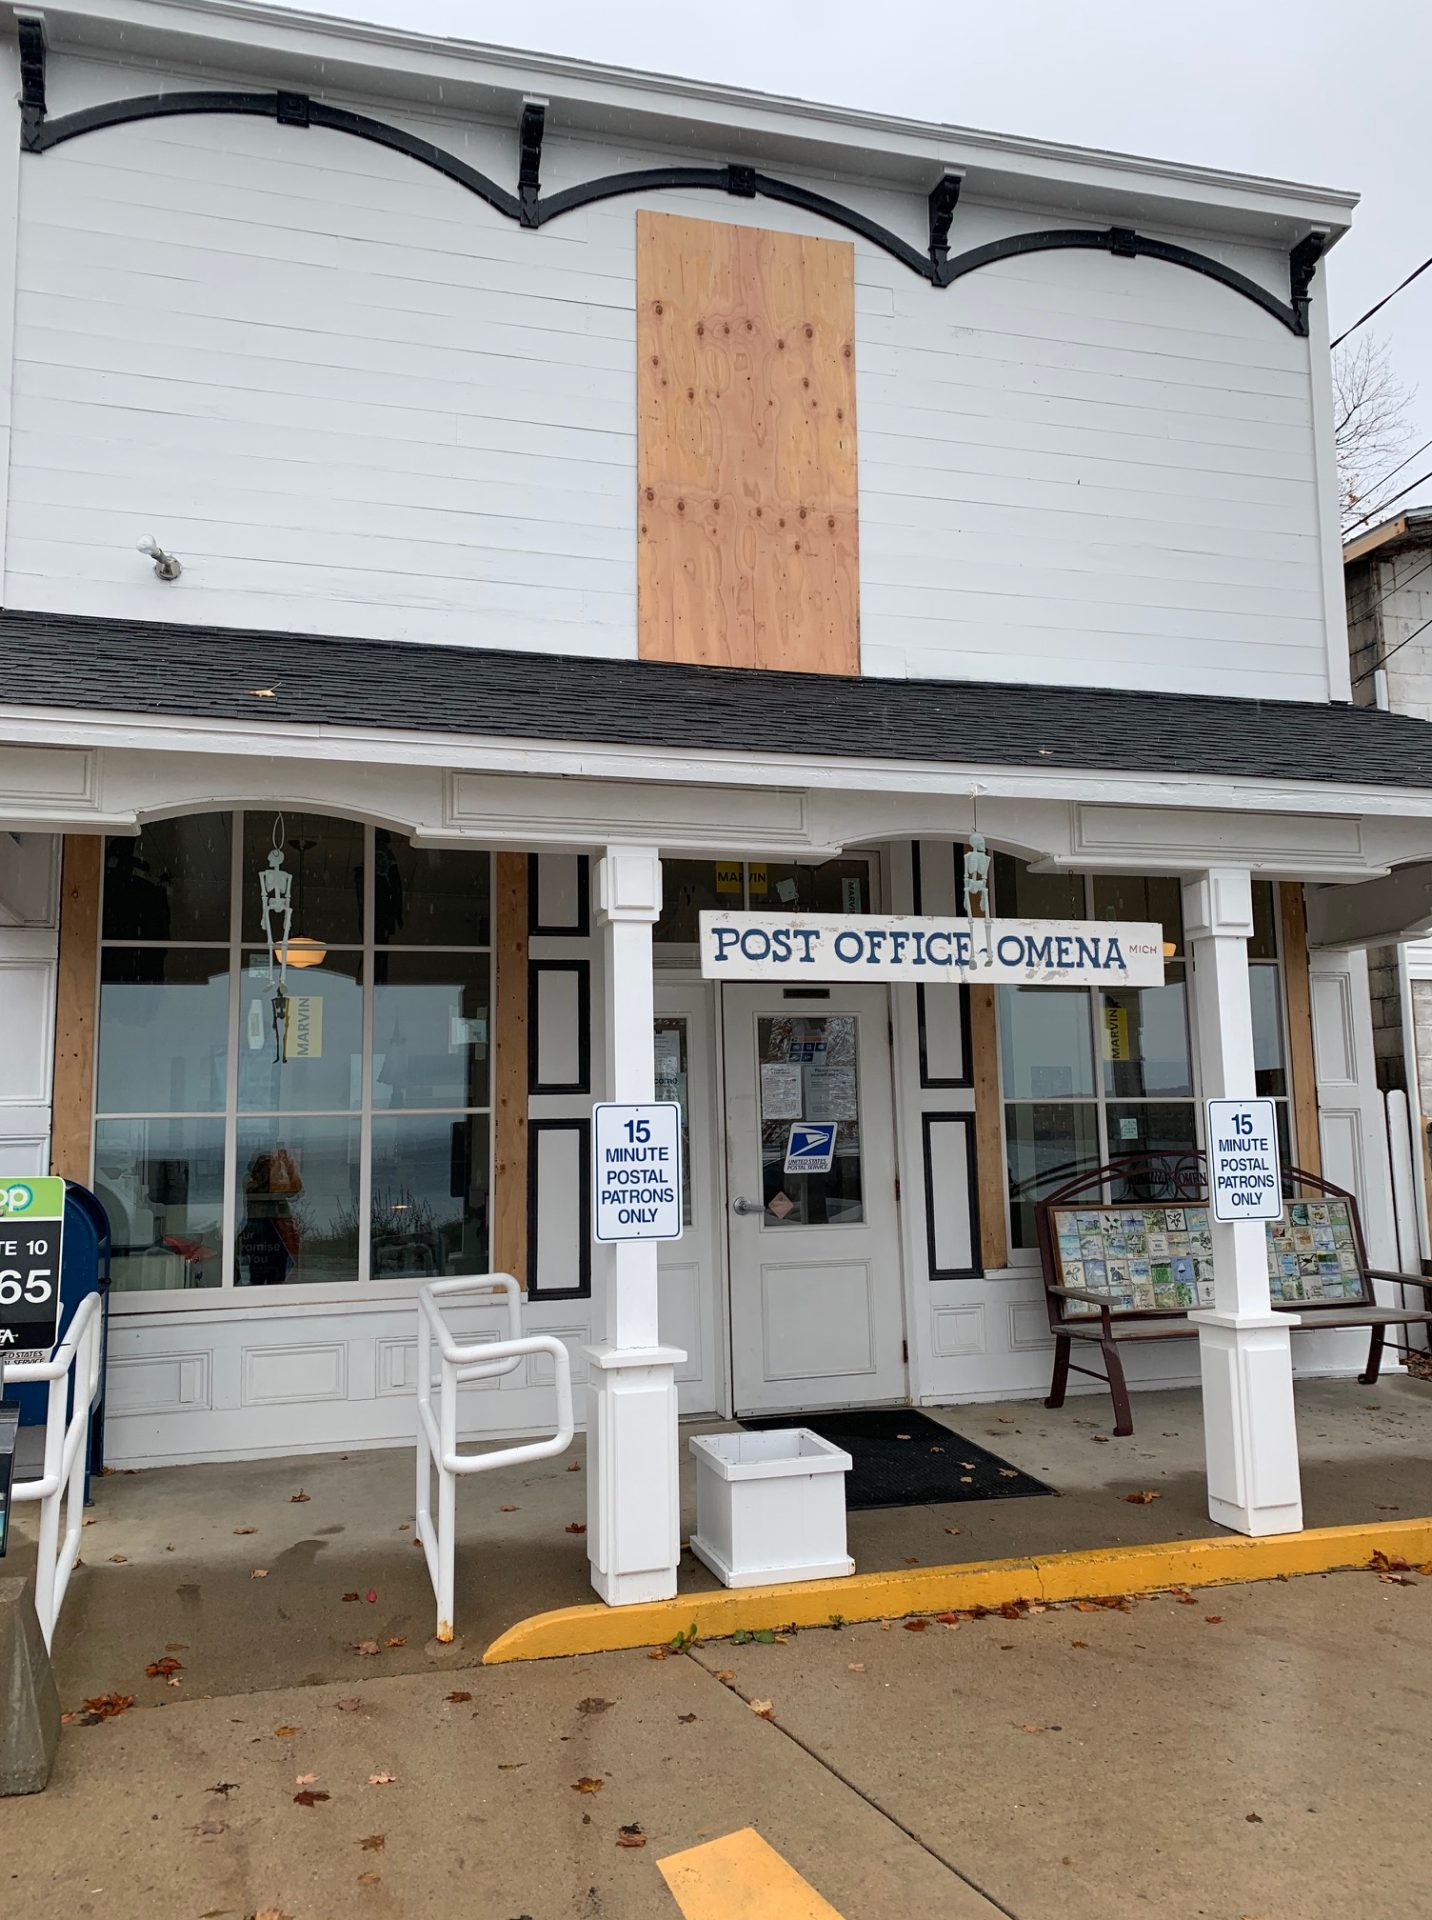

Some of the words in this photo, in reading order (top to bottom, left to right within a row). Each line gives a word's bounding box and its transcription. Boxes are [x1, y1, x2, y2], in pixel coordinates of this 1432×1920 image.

[711, 927, 820, 963] POST
[834, 931, 972, 967] OFFICE
[997, 935, 1127, 970] OMENA
[1128, 944, 1157, 955] MICH
[296, 997, 310, 1056] MARVIN
[1108, 1009, 1121, 1059] MARVIN
[624, 1119, 651, 1144] 15
[1231, 1113, 1253, 1135] 15
[1218, 1138, 1269, 1152] MINUTE
[605, 1147, 669, 1163] MINUTE
[1220, 1157, 1269, 1172] POSTAL
[607, 1168, 669, 1185] POSTAL
[1217, 1174, 1275, 1189] PATRONS
[601, 1187, 674, 1205] PATRONS
[1231, 1192, 1263, 1206] ONLY
[618, 1208, 659, 1224] ONLY
[25, 1239, 49, 1256] 10
[16, 1350, 44, 1358] STATES
